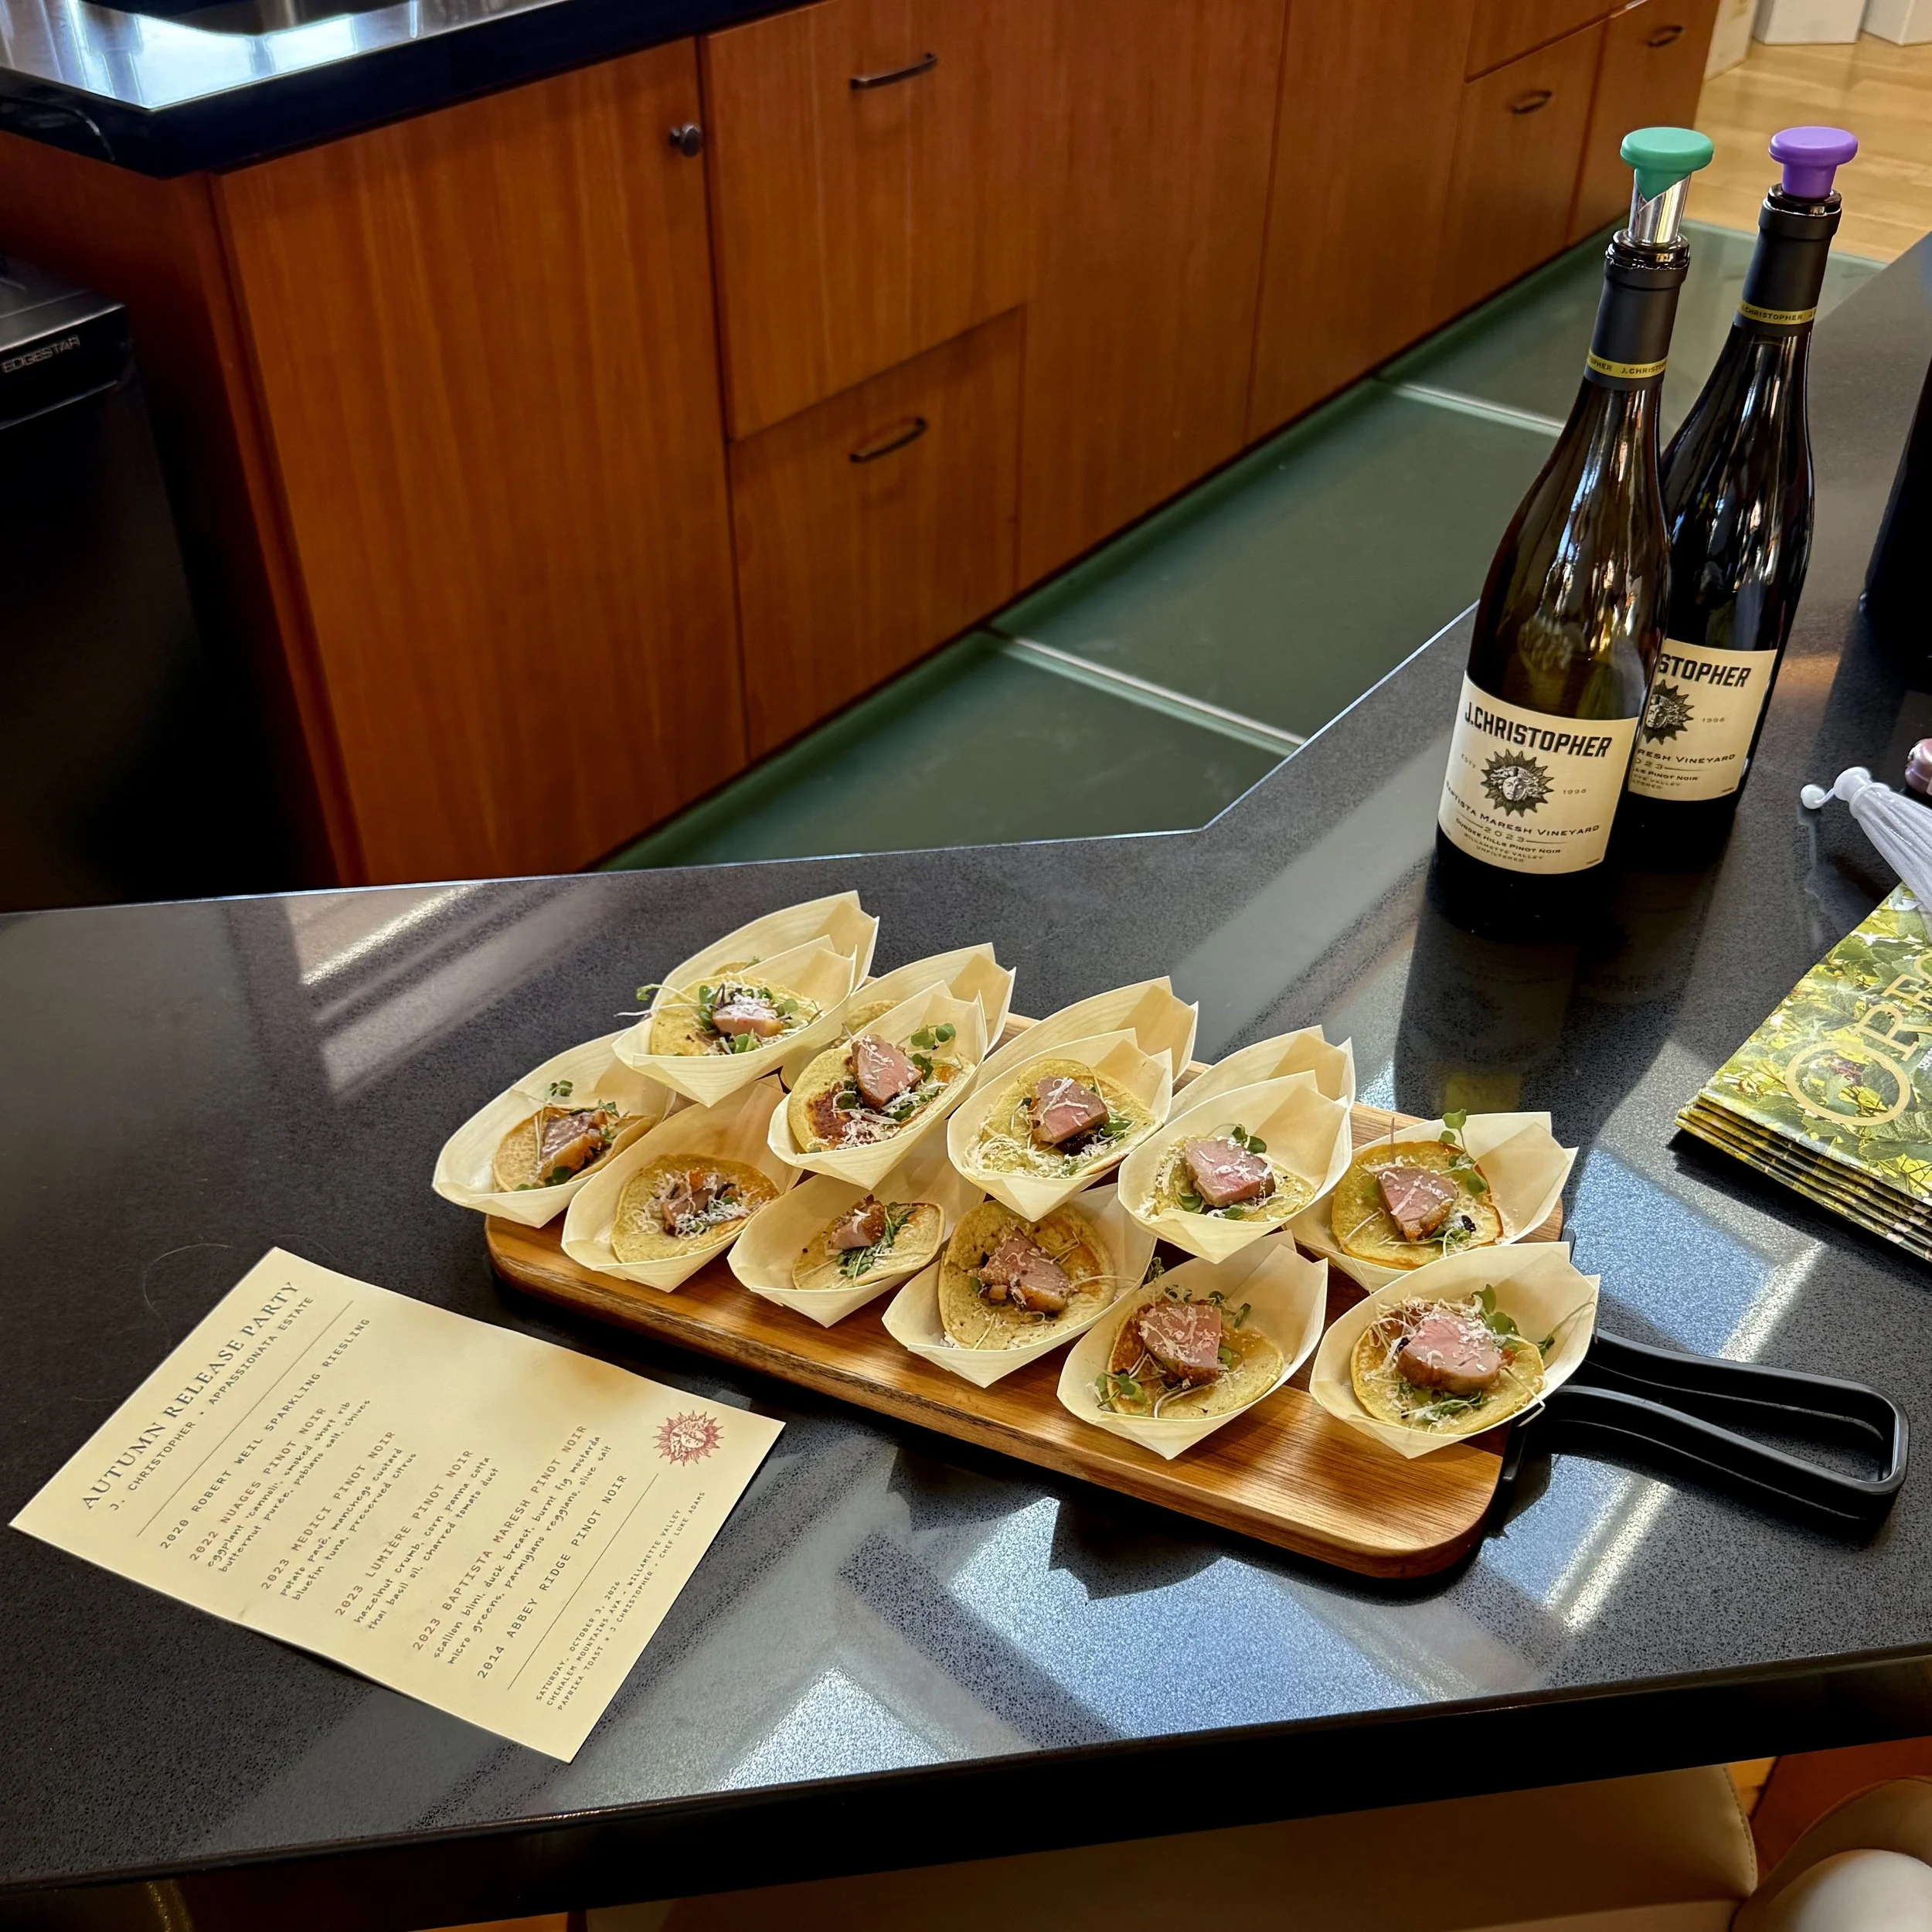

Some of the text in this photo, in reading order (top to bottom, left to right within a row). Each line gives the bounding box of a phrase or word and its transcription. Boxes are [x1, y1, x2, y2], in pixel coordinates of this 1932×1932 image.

[2, 335, 81, 373] EDGESTAR
[1464, 701, 1613, 757] J.CHRISTOPHER
[1675, 753, 1736, 764] VINEYARD
[1480, 813, 1532, 835] MARESH
[1537, 825, 1600, 836] VINEYARD
[1484, 826, 1525, 843] 2023
[1509, 843, 1536, 853] PINOT
[82, 1281, 299, 1511] AUTUMN RELEASE PARTY
[109, 1297, 314, 1511] J. CHRISTOPHER APPASSIONATA ESTATE
[159, 1319, 370, 1549] 2020 ROBERT WEIL SPARKLING RIESLING
[189, 1408, 327, 1561] 2022 NUAGES PINOT NOIR
[207, 1524, 245, 1567] eggplant
[284, 1444, 314, 1476] smoked
[314, 1419, 336, 1441] short
[337, 1402, 351, 1415] rib
[218, 1525, 262, 1573] butternut
[292, 1452, 325, 1486] poblano
[344, 1400, 371, 1427] chives
[260, 1431, 396, 1590] 2023 MEDICI PINOT NOIR
[279, 1566, 306, 1597] potato
[330, 1485, 372, 1531] manchego
[372, 1447, 403, 1481] custard
[291, 1566, 325, 1600] bluefin
[349, 1481, 393, 1533] preserved
[392, 1453, 417, 1479] citrus
[334, 1451, 474, 1616] 2023 LUMIÈRE PINOT NOIR
[352, 1577, 393, 1624] hazelnut
[423, 1515, 444, 1537] corn
[444, 1483, 471, 1512] panna
[470, 1458, 491, 1478] cotta
[367, 1610, 387, 1630] thai
[385, 1582, 409, 1606] basil
[423, 1521, 457, 1562] charred
[454, 1490, 481, 1519] tomato
[480, 1467, 499, 1487] dust
[412, 1426, 587, 1651] 2023 BAPTISTA MARESH PINOT NOIR
[434, 1621, 463, 1658] scallion
[483, 1564, 505, 1588] duck
[531, 1495, 557, 1522] burnt
[554, 1478, 573, 1491] fig
[569, 1437, 601, 1474] mostarda
[447, 1637, 471, 1665] micro
[504, 1536, 545, 1589] parmigiano
[579, 1466, 597, 1486] olive
[597, 1445, 612, 1461] salt
[608, 1600, 622, 1614] AVA
[626, 1539, 662, 1587] WILLAMETTE
[659, 1509, 681, 1536] VALLEY
[477, 1475, 628, 1679] 2014 ABBEY RIDGE PINOT NOIR
[557, 1675, 585, 1711] PAPRIKA
[583, 1645, 604, 1671] TOAST
[616, 1570, 654, 1623] CHRISTOPHER
[569, 1617, 596, 1652] OCTOBER
